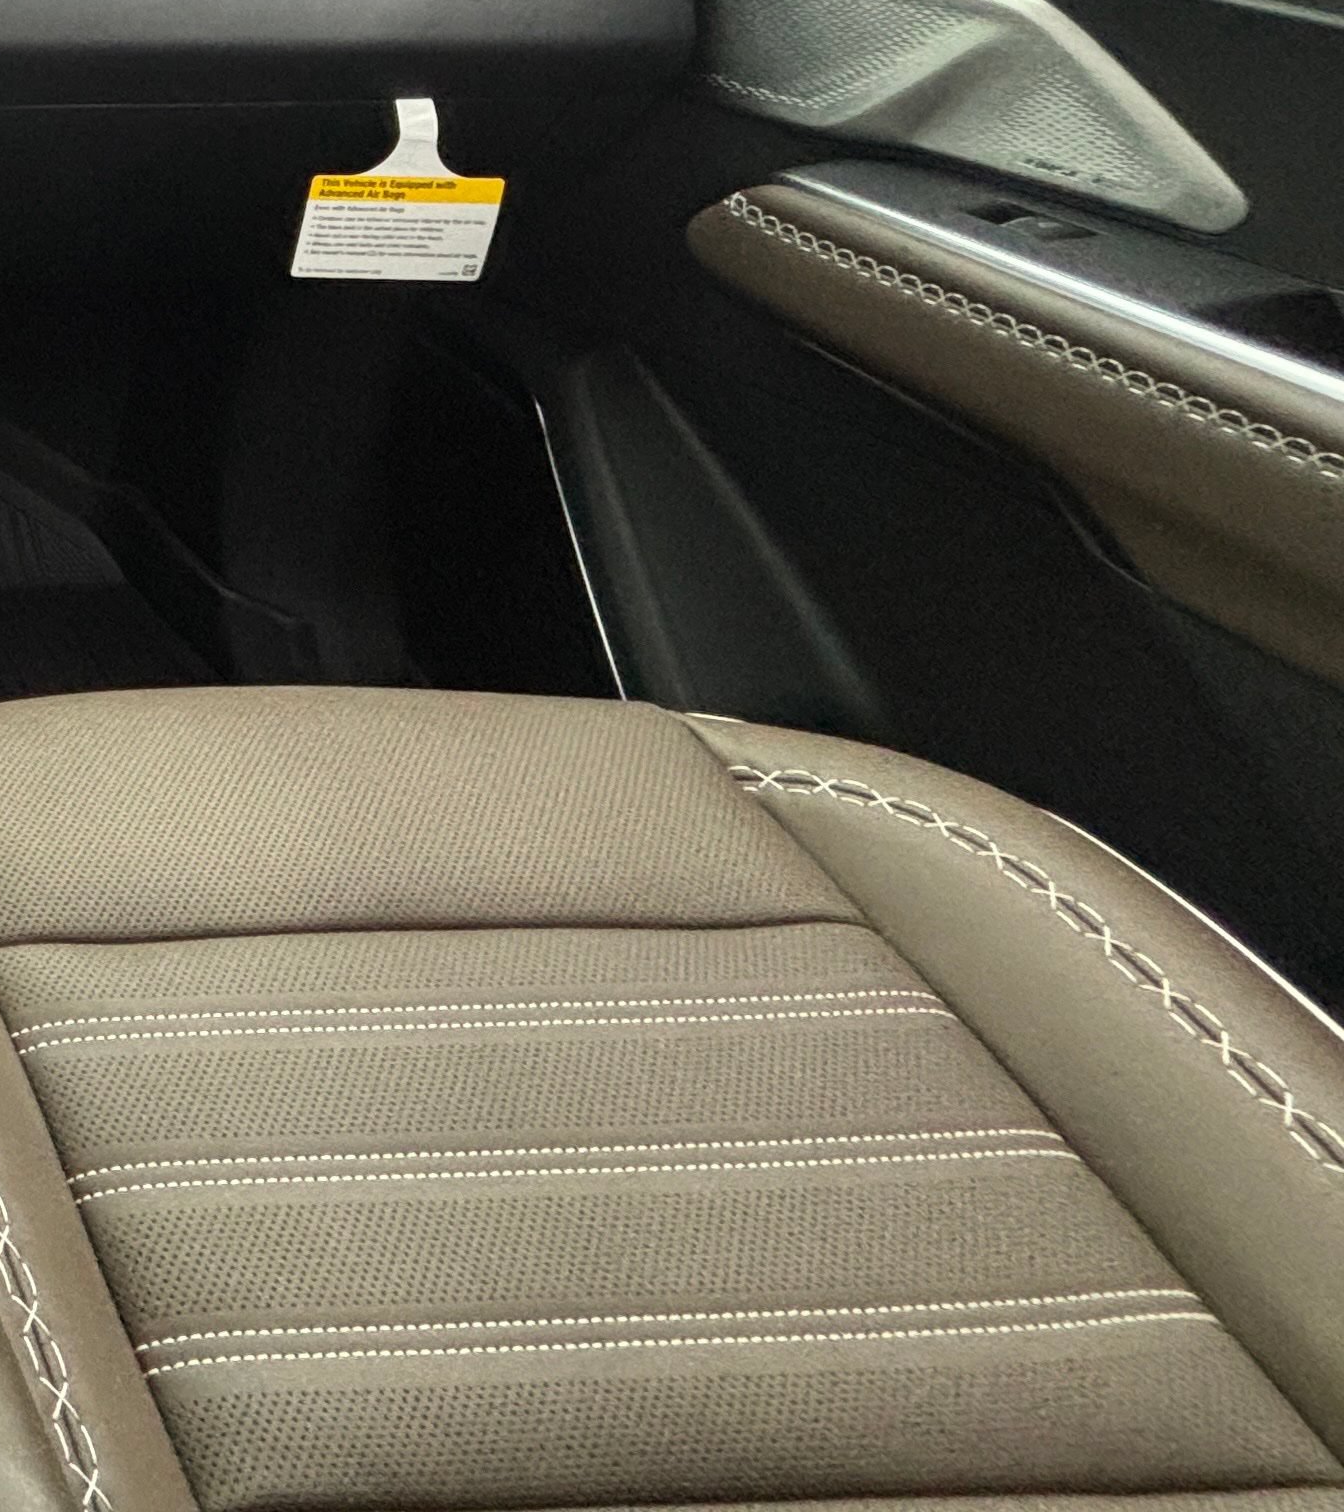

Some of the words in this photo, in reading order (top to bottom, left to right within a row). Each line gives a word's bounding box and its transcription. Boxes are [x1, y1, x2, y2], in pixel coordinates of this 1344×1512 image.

[321, 179, 341, 188] This
[343, 179, 377, 189] Vehicle
[389, 180, 433, 191] Equipped
[436, 181, 457, 189] with
[319, 189, 365, 199] Advanced
[368, 190, 380, 199] Air
[383, 190, 406, 200] Bags
